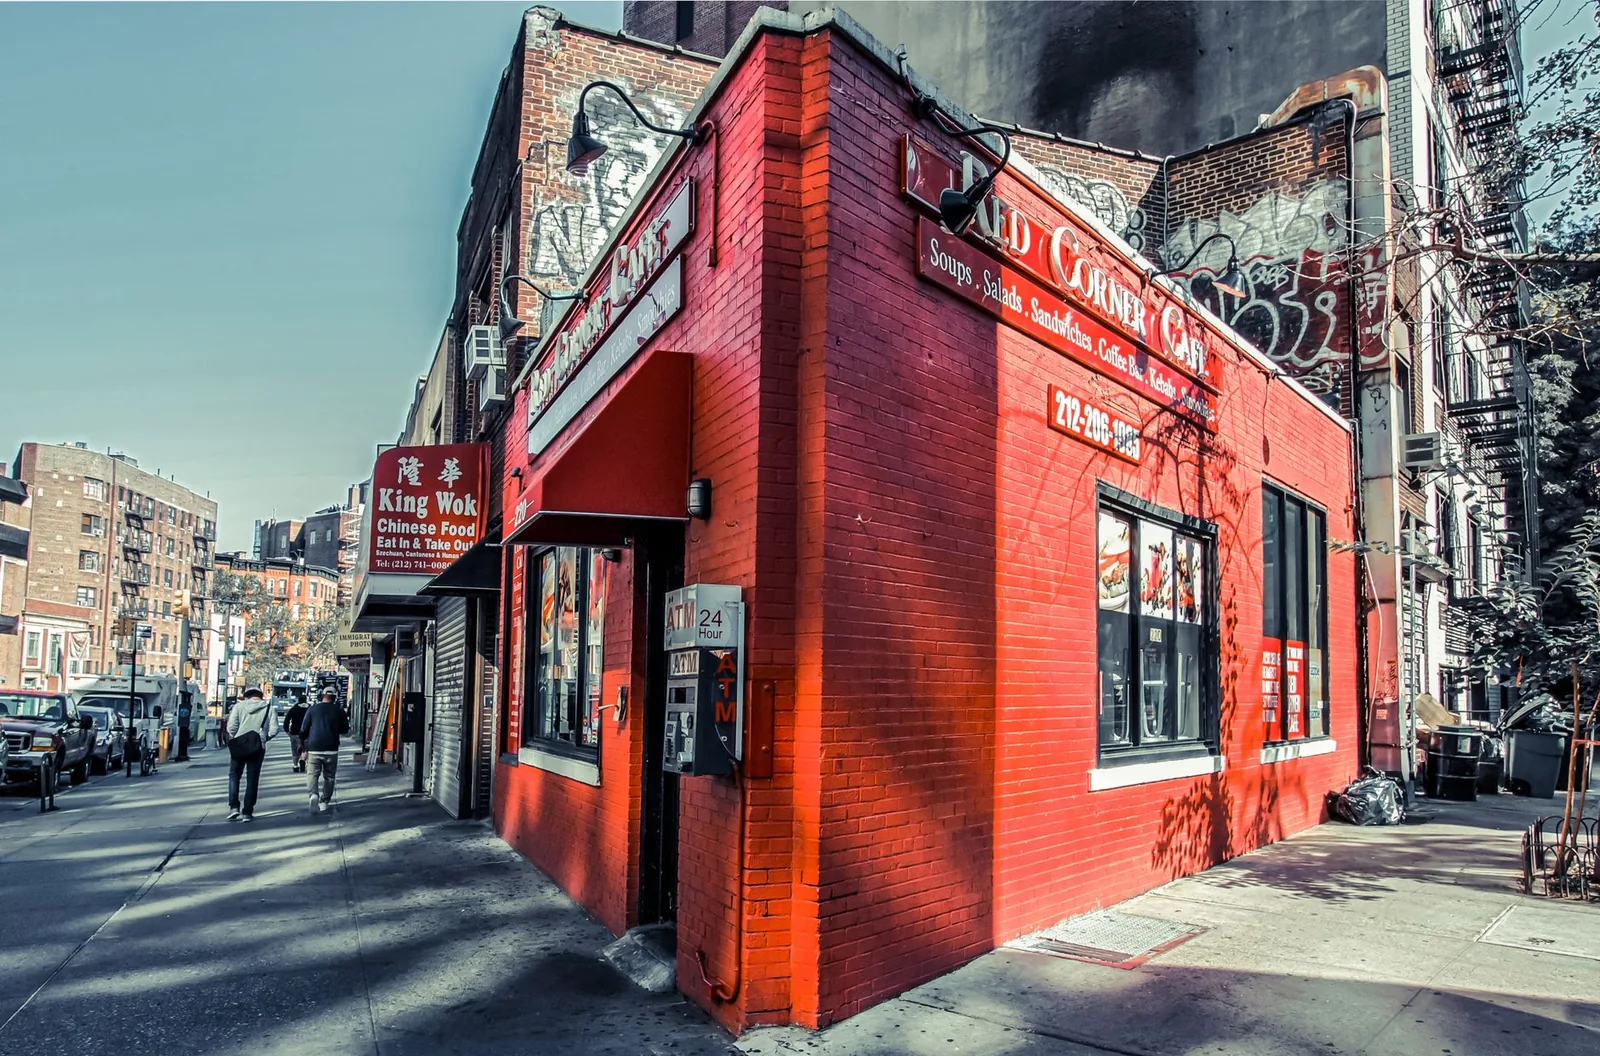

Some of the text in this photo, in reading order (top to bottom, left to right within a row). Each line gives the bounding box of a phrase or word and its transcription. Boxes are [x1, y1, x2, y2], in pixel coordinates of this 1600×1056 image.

[1049, 226, 1146, 335] CORNER
[930, 238, 972, 287] Soups
[983, 269, 1023, 313] Salads
[1031, 300, 1093, 356] Sandwiches
[1098, 339, 1128, 373] Coffee
[1128, 354, 1143, 382] Bar
[1149, 367, 1176, 399] Kebabs
[378, 487, 478, 520] King Wok
[377, 518, 476, 537] Chinese Food
[376, 536, 475, 551] Eat In & Take Out
[376, 560, 390, 568] Tel:
[391, 560, 412, 569] (212)
[405, 551, 436, 559] Cantonese
[666, 600, 695, 631] ATM
[699, 609, 723, 628] 24
[698, 627, 723, 640] Hour
[672, 651, 698, 674] ATM
[716, 653, 736, 723] ATM
